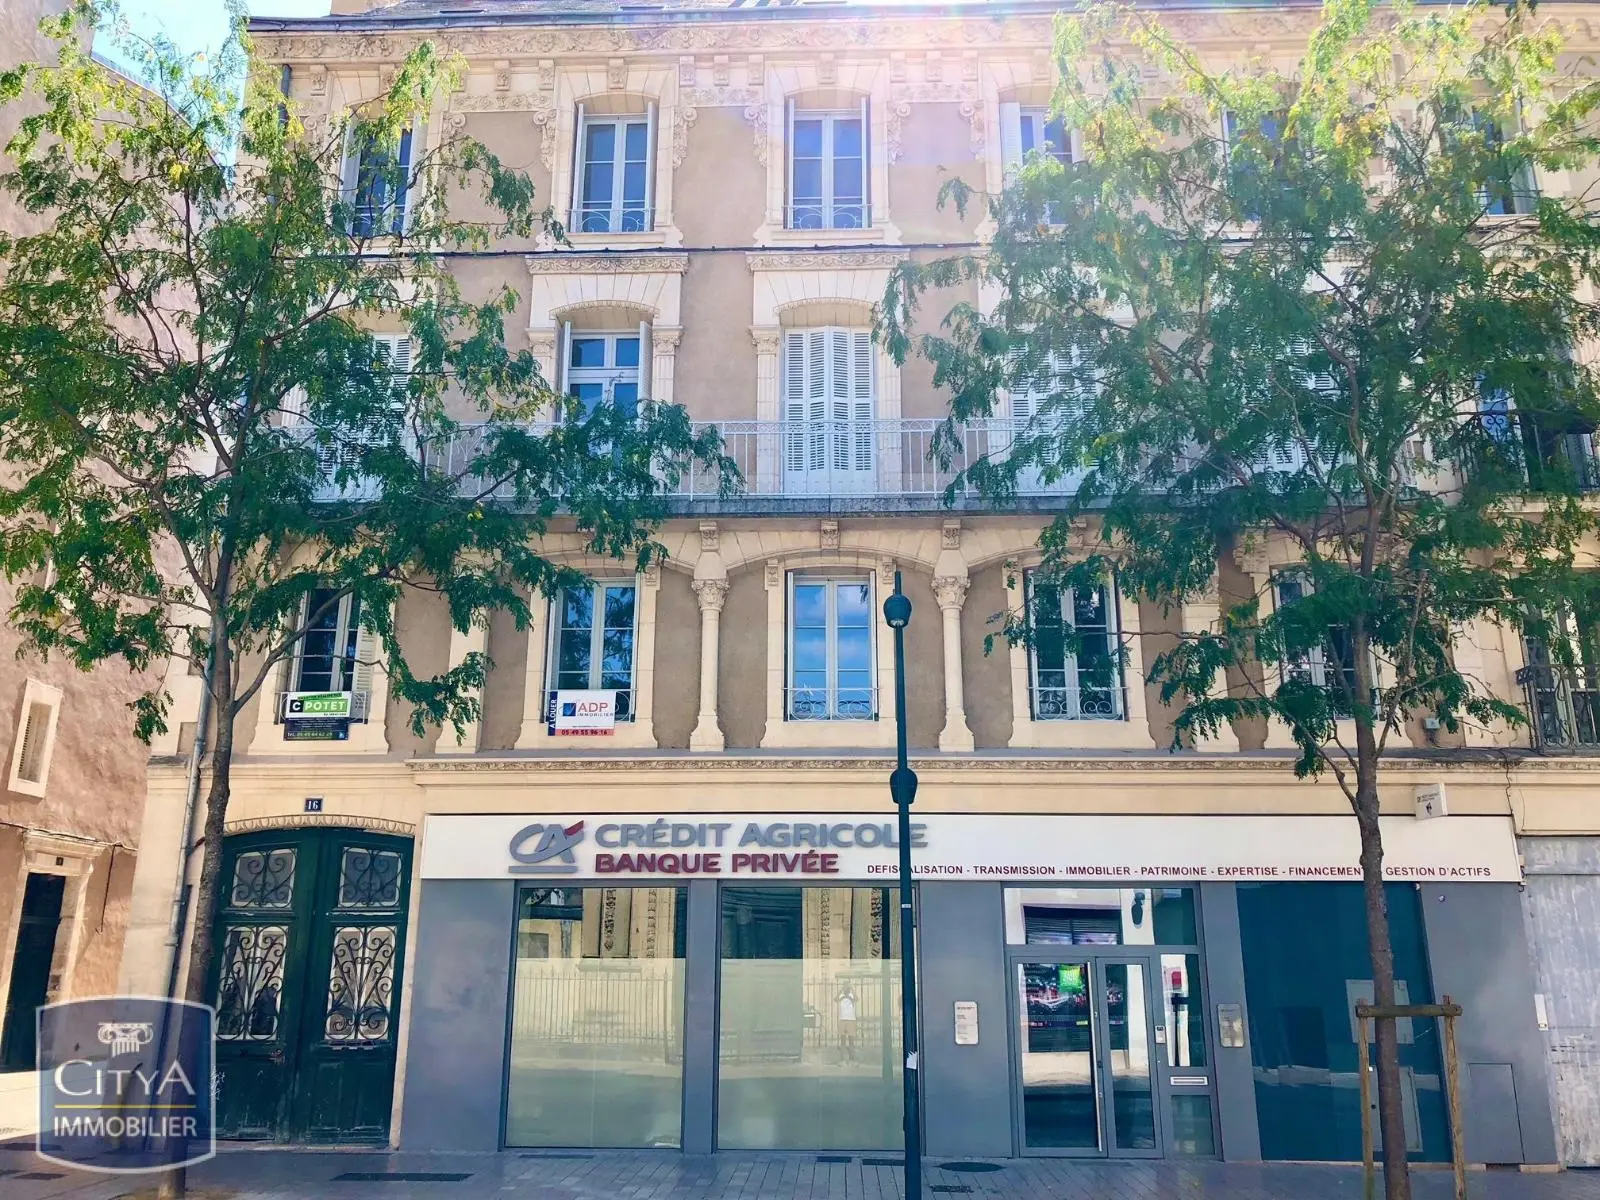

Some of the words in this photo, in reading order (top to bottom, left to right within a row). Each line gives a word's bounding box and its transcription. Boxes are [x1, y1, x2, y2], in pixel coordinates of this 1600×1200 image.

[292, 702, 301, 711] C
[305, 702, 345, 711] POTET
[549, 699, 557, 722] LOUER
[577, 702, 609, 713] ADP
[307, 800, 319, 810] 16
[594, 818, 731, 849] CRÉDIT
[738, 822, 929, 849] AGRICOLE
[595, 853, 722, 873] BANQUE
[731, 850, 840, 873] PRIVÉE
[867, 865, 963, 874] DEFISLISATION
[973, 865, 1056, 875] TRANSMISSION
[1065, 866, 1131, 876] IMMOBILIER
[1141, 866, 1207, 876] PATRIMOINE
[1217, 866, 1279, 876] EXPERTISE
[1289, 866, 1364, 876] FINANCEMEN
[1385, 866, 1436, 876] GESTION
[1439, 866, 1491, 877] D'ACTIFS
